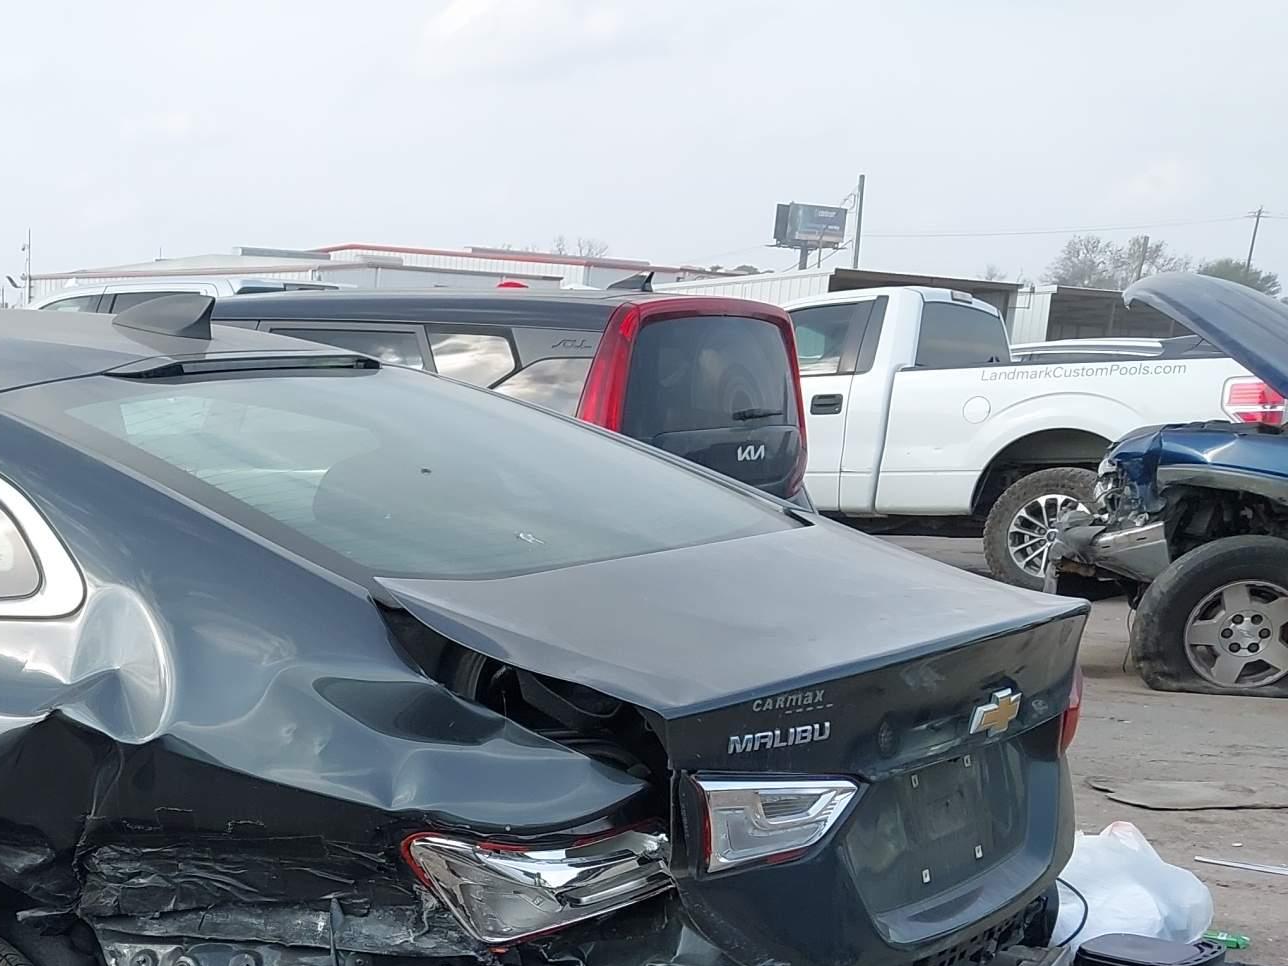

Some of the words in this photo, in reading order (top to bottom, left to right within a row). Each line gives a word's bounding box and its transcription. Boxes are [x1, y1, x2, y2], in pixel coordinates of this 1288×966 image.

[980, 363, 1187, 382] LandmarkCustomPools.com
[737, 444, 765, 461] KIA
[727, 721, 831, 754] MALIBU
